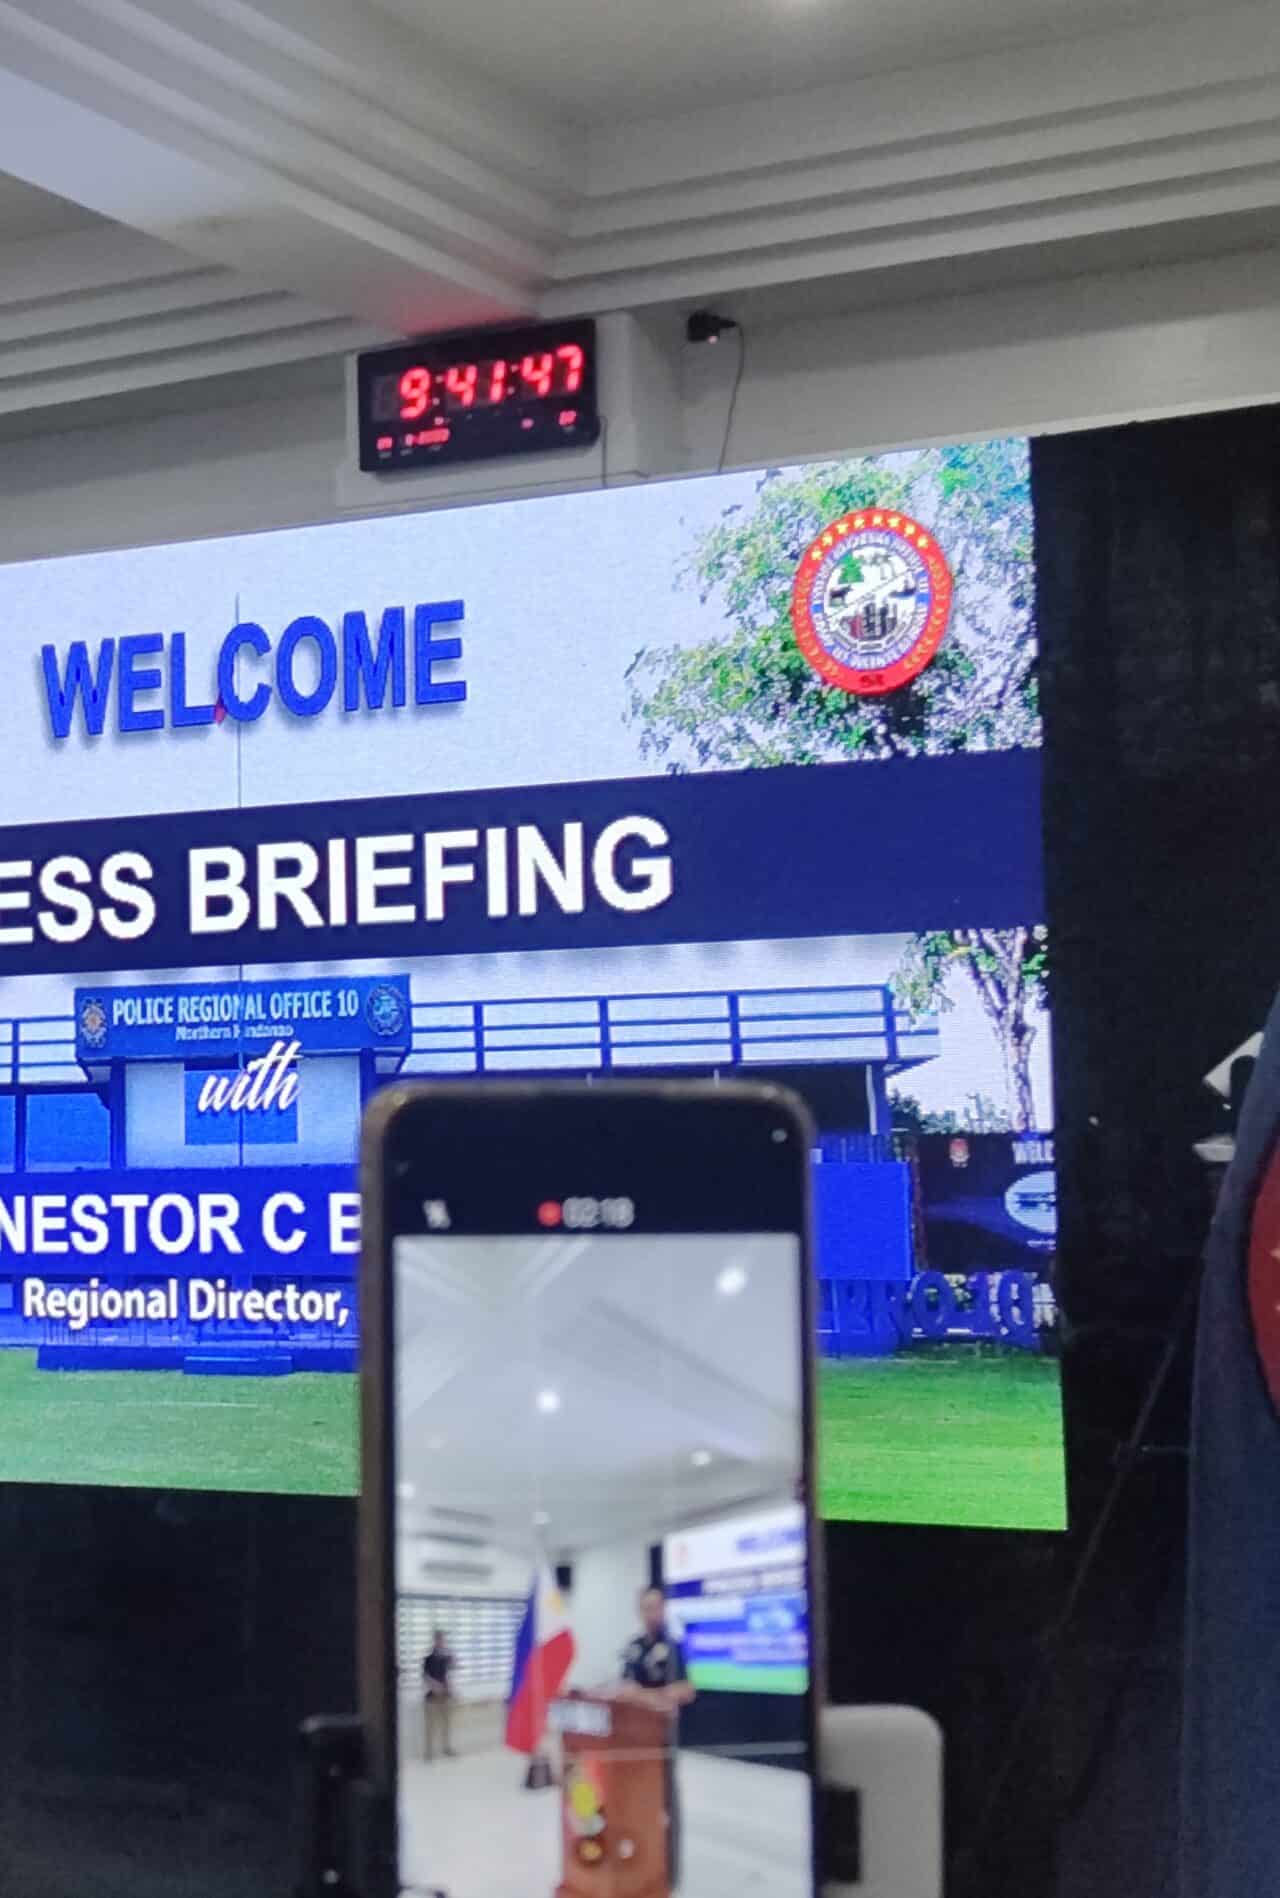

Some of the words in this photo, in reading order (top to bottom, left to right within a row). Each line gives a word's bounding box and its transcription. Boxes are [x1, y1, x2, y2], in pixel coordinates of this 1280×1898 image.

[399, 345, 585, 420] 9:41:47
[41, 600, 467, 738] WELCOME
[189, 816, 673, 934] BRIEFING
[113, 998, 173, 1025] POLICE
[177, 993, 266, 1023] REGIONAL
[270, 991, 332, 1020] OFFICE
[338, 989, 359, 1017] 10
[197, 1040, 304, 1112] with
[262, 1192, 306, 1254] C
[23, 1277, 178, 1329] Regional
[189, 1279, 350, 1327] Director,
